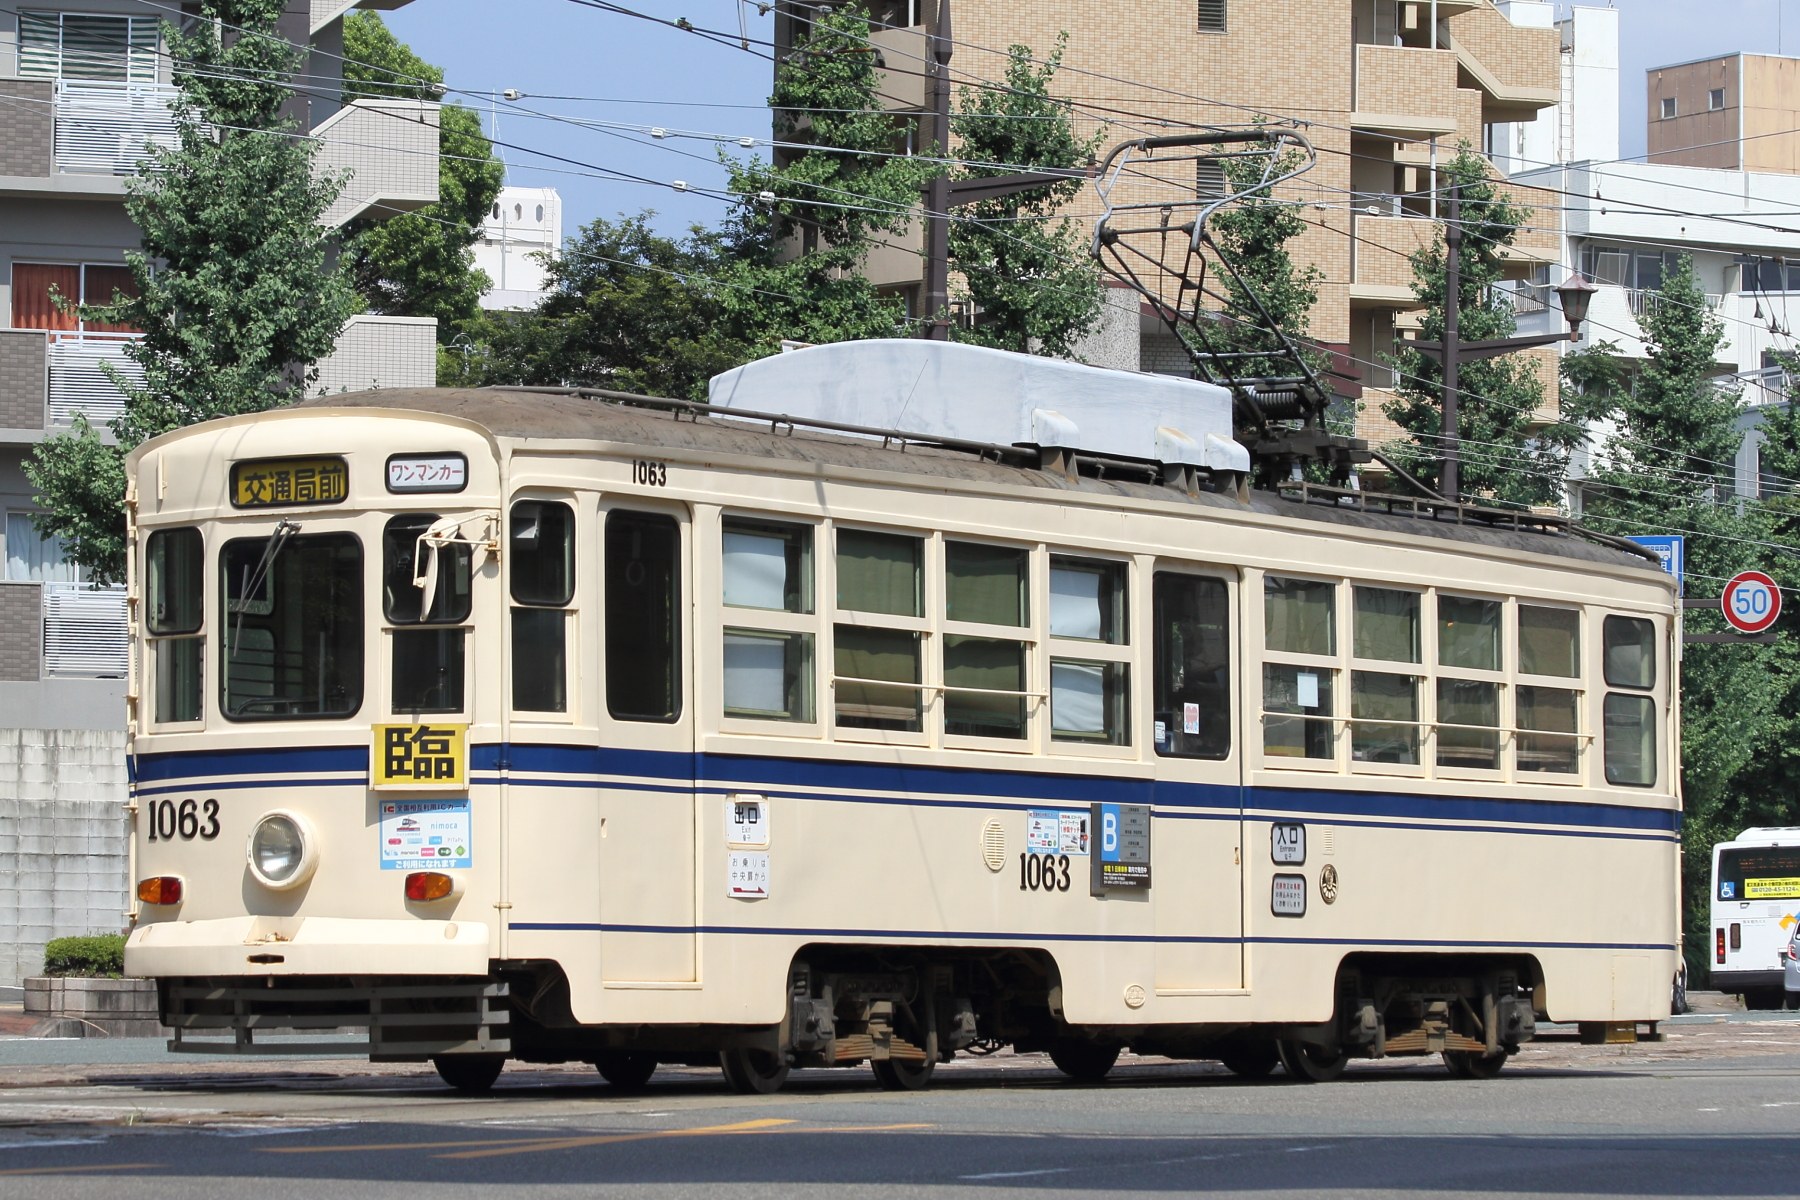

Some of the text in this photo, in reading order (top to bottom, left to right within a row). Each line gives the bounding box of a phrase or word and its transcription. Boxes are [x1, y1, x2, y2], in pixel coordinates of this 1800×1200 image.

[244, 466, 342, 504] 交通局前
[391, 464, 463, 482] ワンマンカー
[632, 459, 667, 487] 1063
[1735, 588, 1767, 615] 50
[384, 725, 456, 779] 臨
[148, 798, 221, 841] 1063
[430, 821, 457, 830] nimoca
[734, 805, 758, 824] 出口
[1103, 812, 1117, 852] B
[1277, 826, 1298, 845] 入口
[1019, 852, 1071, 893] 1063
